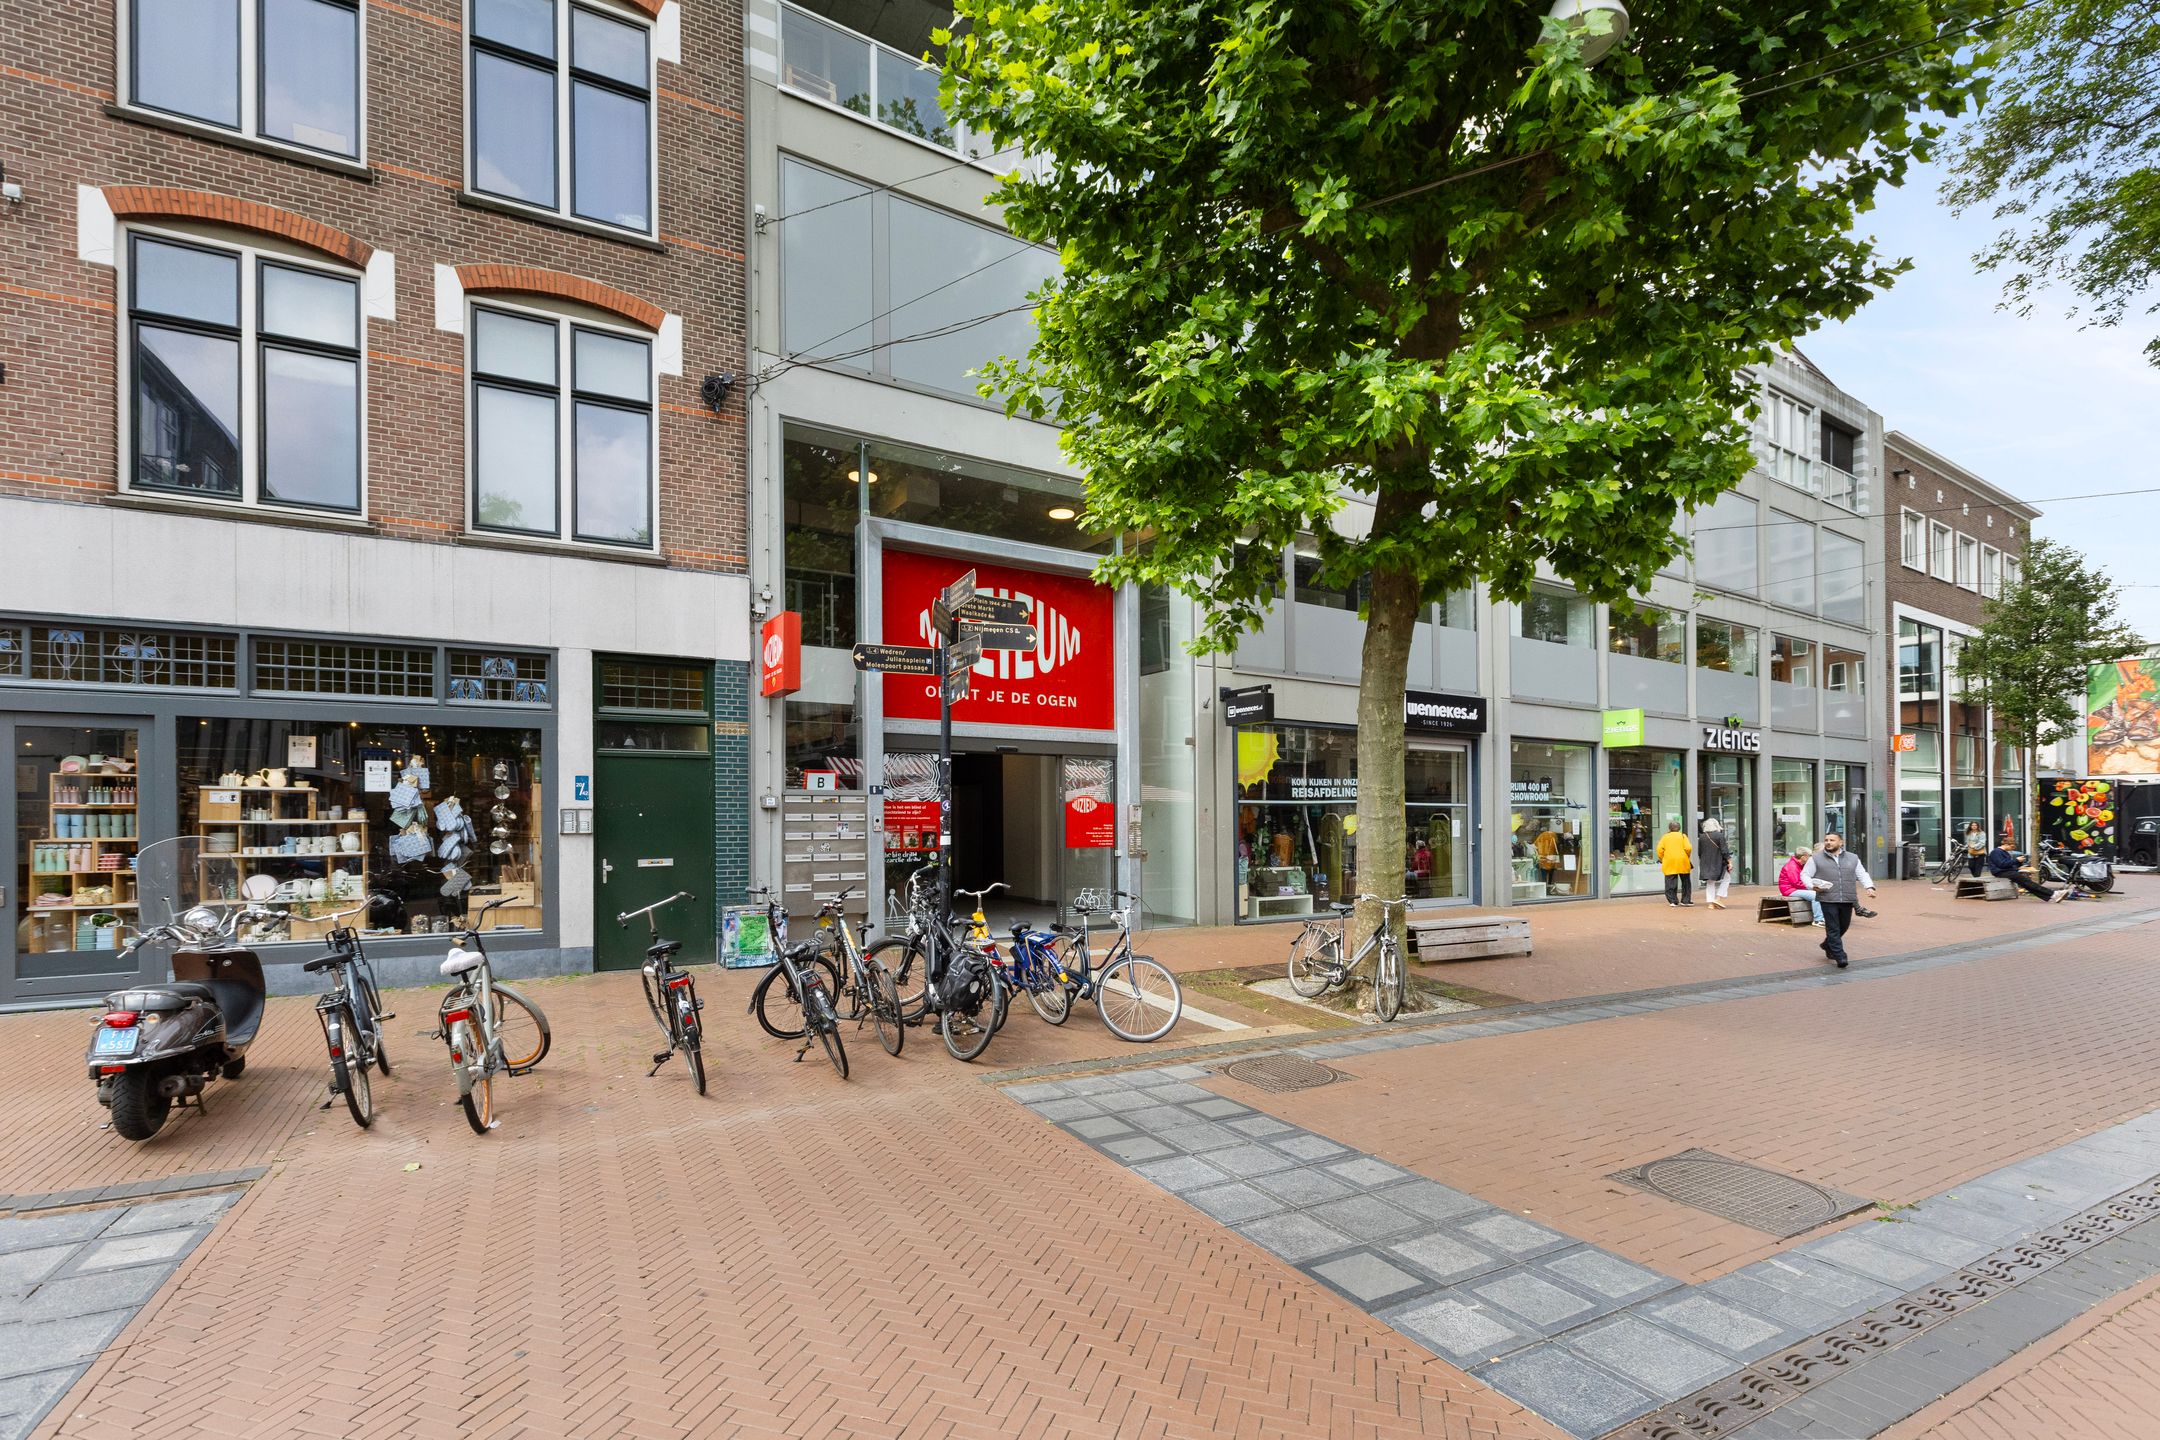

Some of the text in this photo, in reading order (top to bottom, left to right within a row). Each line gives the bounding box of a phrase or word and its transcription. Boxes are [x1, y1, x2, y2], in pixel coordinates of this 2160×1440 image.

[977, 603, 994, 612] Markt
[974, 625, 1004, 634] Nijmegen
[879, 648, 907, 656] Wedren/
[885, 656, 926, 664] Julianaplein
[865, 661, 929, 672] Molenpoort passage
[987, 690, 1005, 703] JE
[1011, 692, 1031, 704] DE
[1036, 693, 1078, 708] OGEN
[1705, 728, 1761, 752] ZIENGS
[817, 776, 826, 788] B
[1291, 778, 1308, 786] KOM
[1308, 778, 1332, 786] KIJKEN
[1333, 778, 1342, 786] IN
[1511, 782, 1527, 792] RUIM
[1527, 782, 1540, 792] 400
[1291, 787, 1358, 798] REISAFDELING
[1510, 792, 1550, 801] SHOWROOM
